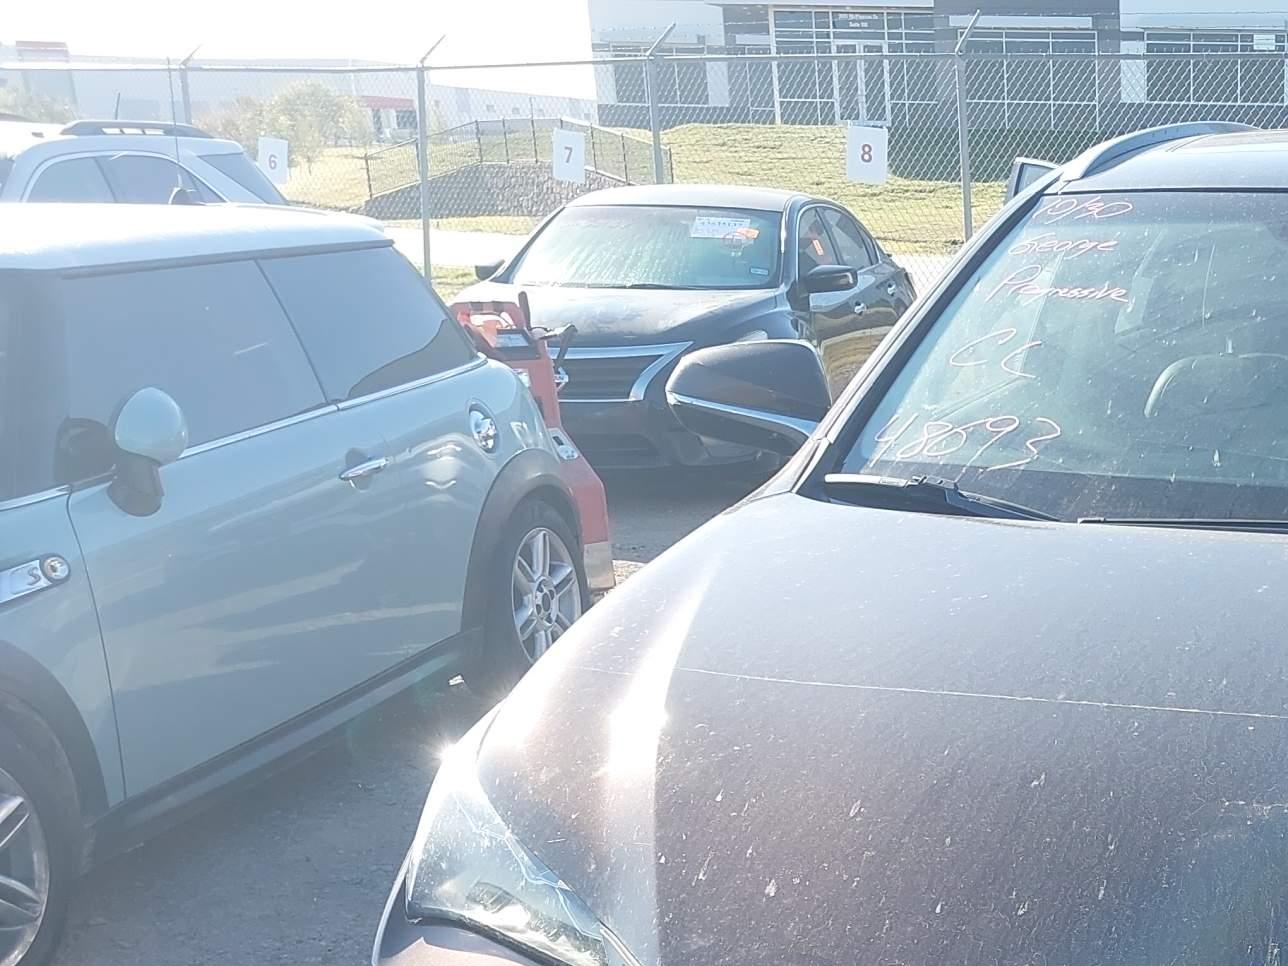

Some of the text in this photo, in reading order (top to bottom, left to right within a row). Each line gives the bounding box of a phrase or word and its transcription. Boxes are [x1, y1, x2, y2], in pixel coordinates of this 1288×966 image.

[564, 146, 573, 163] 7
[861, 143, 873, 163] 8
[268, 154, 278, 170] 6
